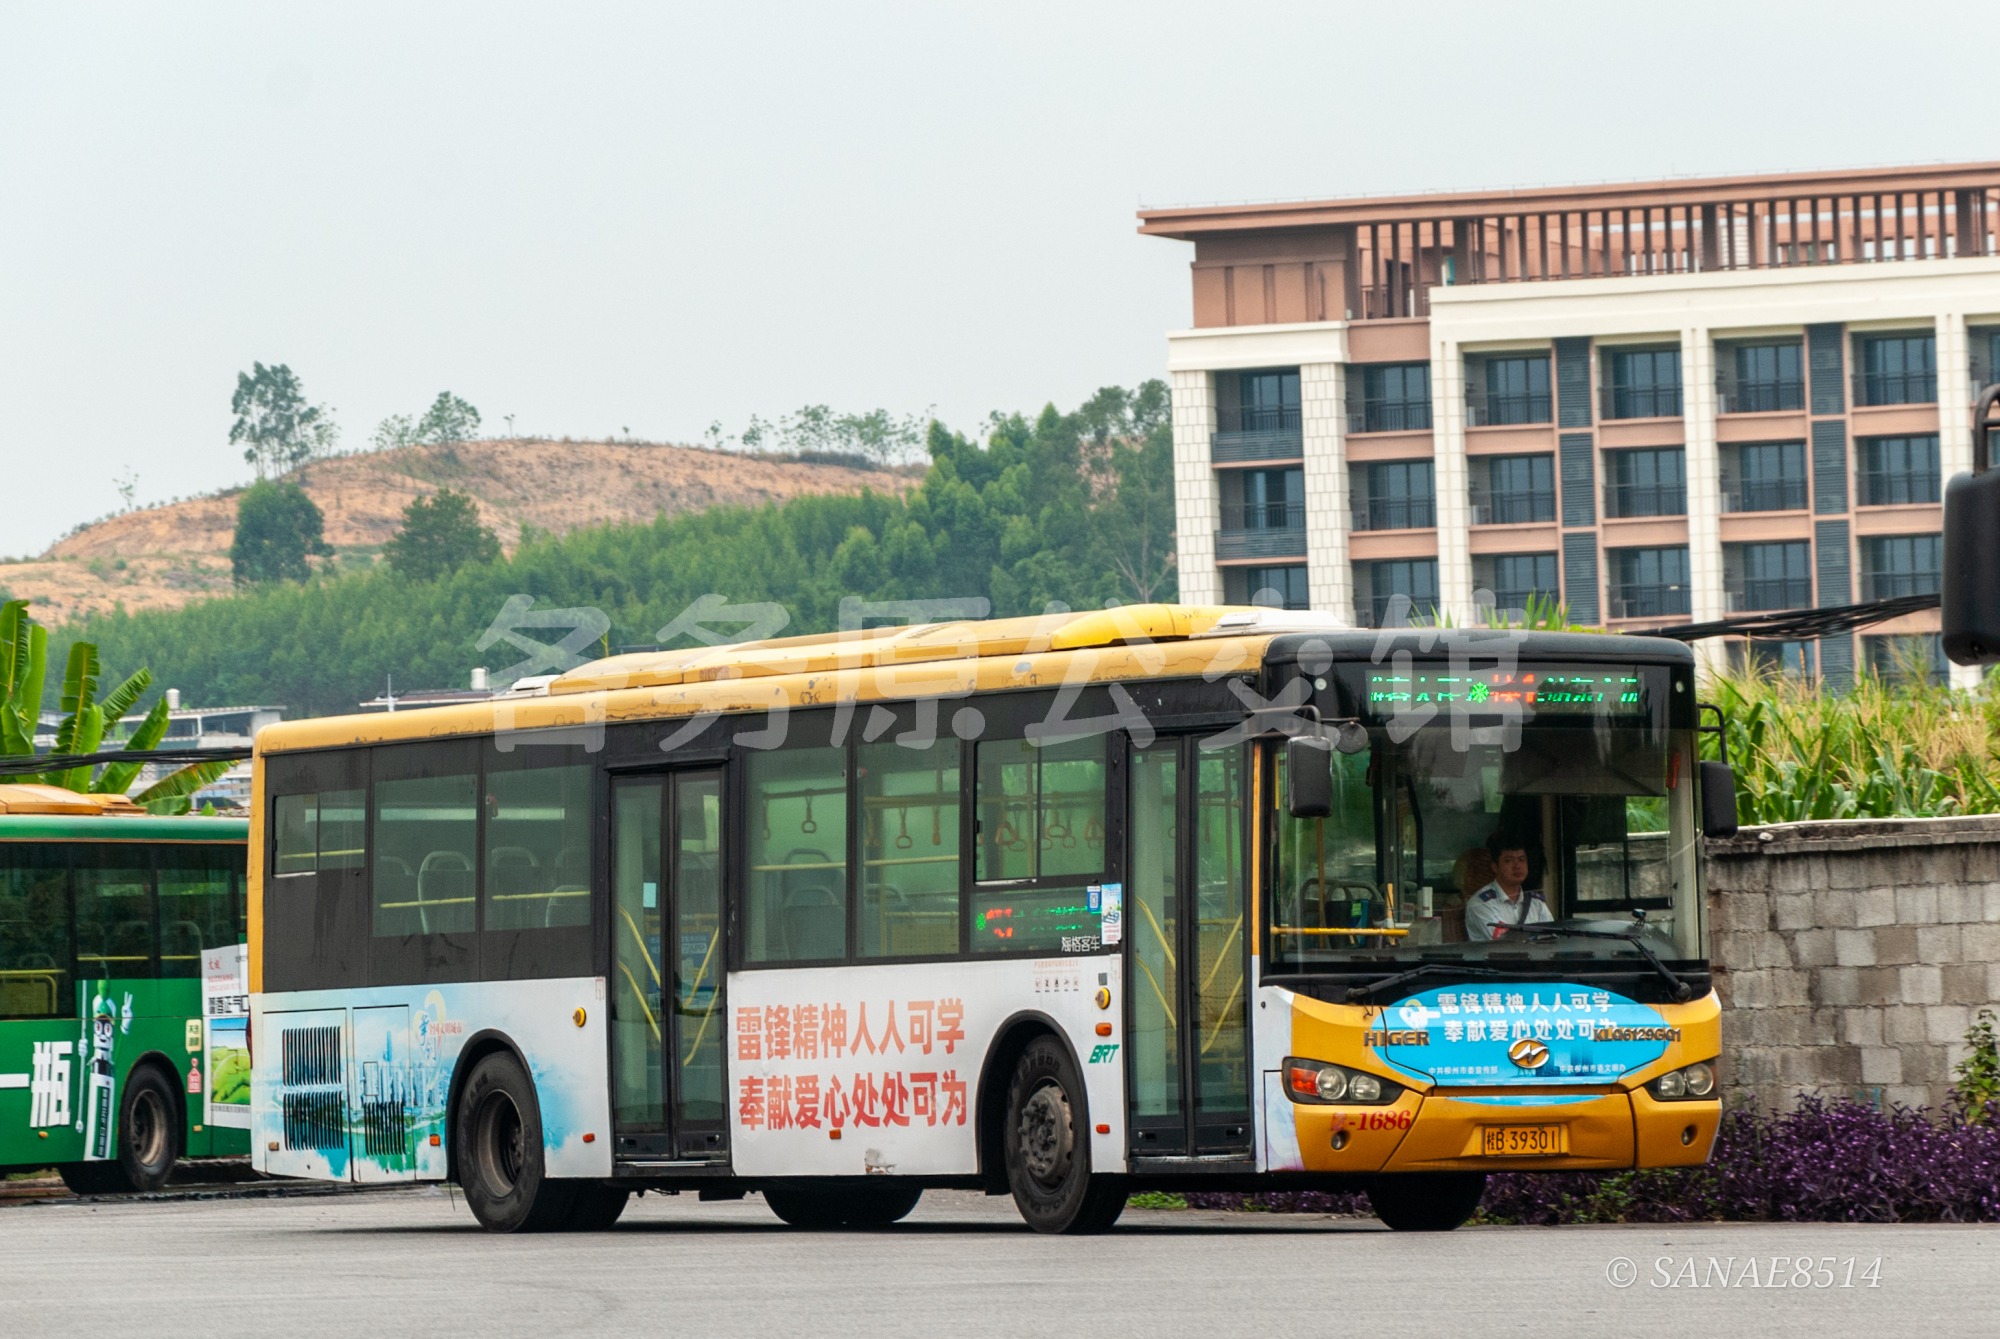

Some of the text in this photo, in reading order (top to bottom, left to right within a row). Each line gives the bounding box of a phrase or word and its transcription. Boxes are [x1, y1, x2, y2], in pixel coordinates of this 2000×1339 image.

[1061, 935, 1100, 953] 海格客车
[1437, 992, 1614, 1015] 雷锋精神人人可学
[736, 998, 965, 1061] 雷锋精神人人可学
[1363, 1030, 1430, 1047] HIGER
[1088, 1044, 1120, 1064] BRT
[738, 1069, 967, 1131] 奉献爱心处处可为
